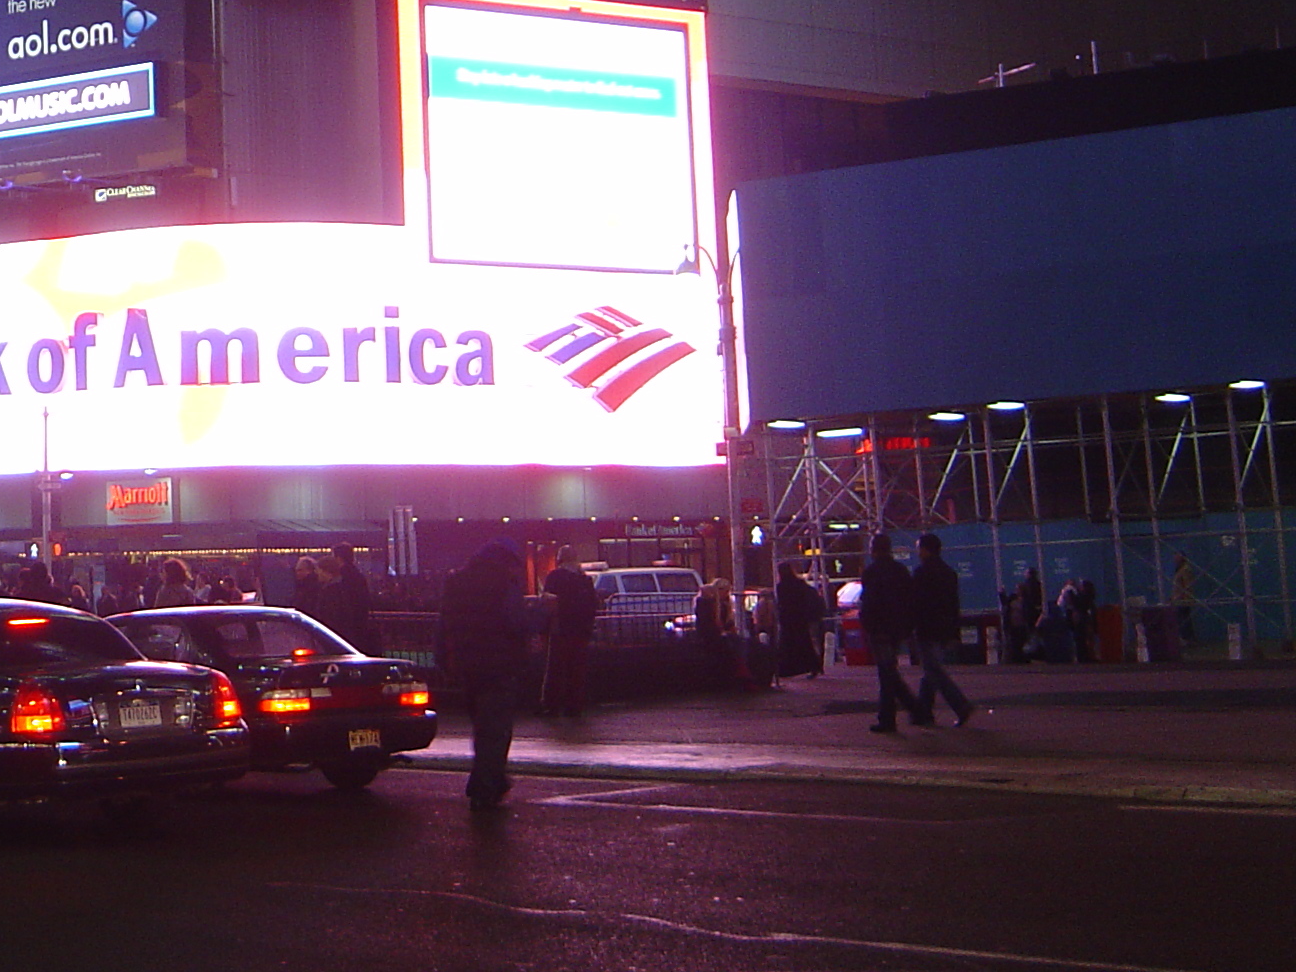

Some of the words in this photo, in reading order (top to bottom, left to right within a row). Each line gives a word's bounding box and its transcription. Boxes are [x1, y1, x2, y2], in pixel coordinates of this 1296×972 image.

[7, 19, 115, 60] aol.com
[26, 310, 99, 395] of
[113, 305, 496, 389] America
[105, 481, 169, 510] Marriott
